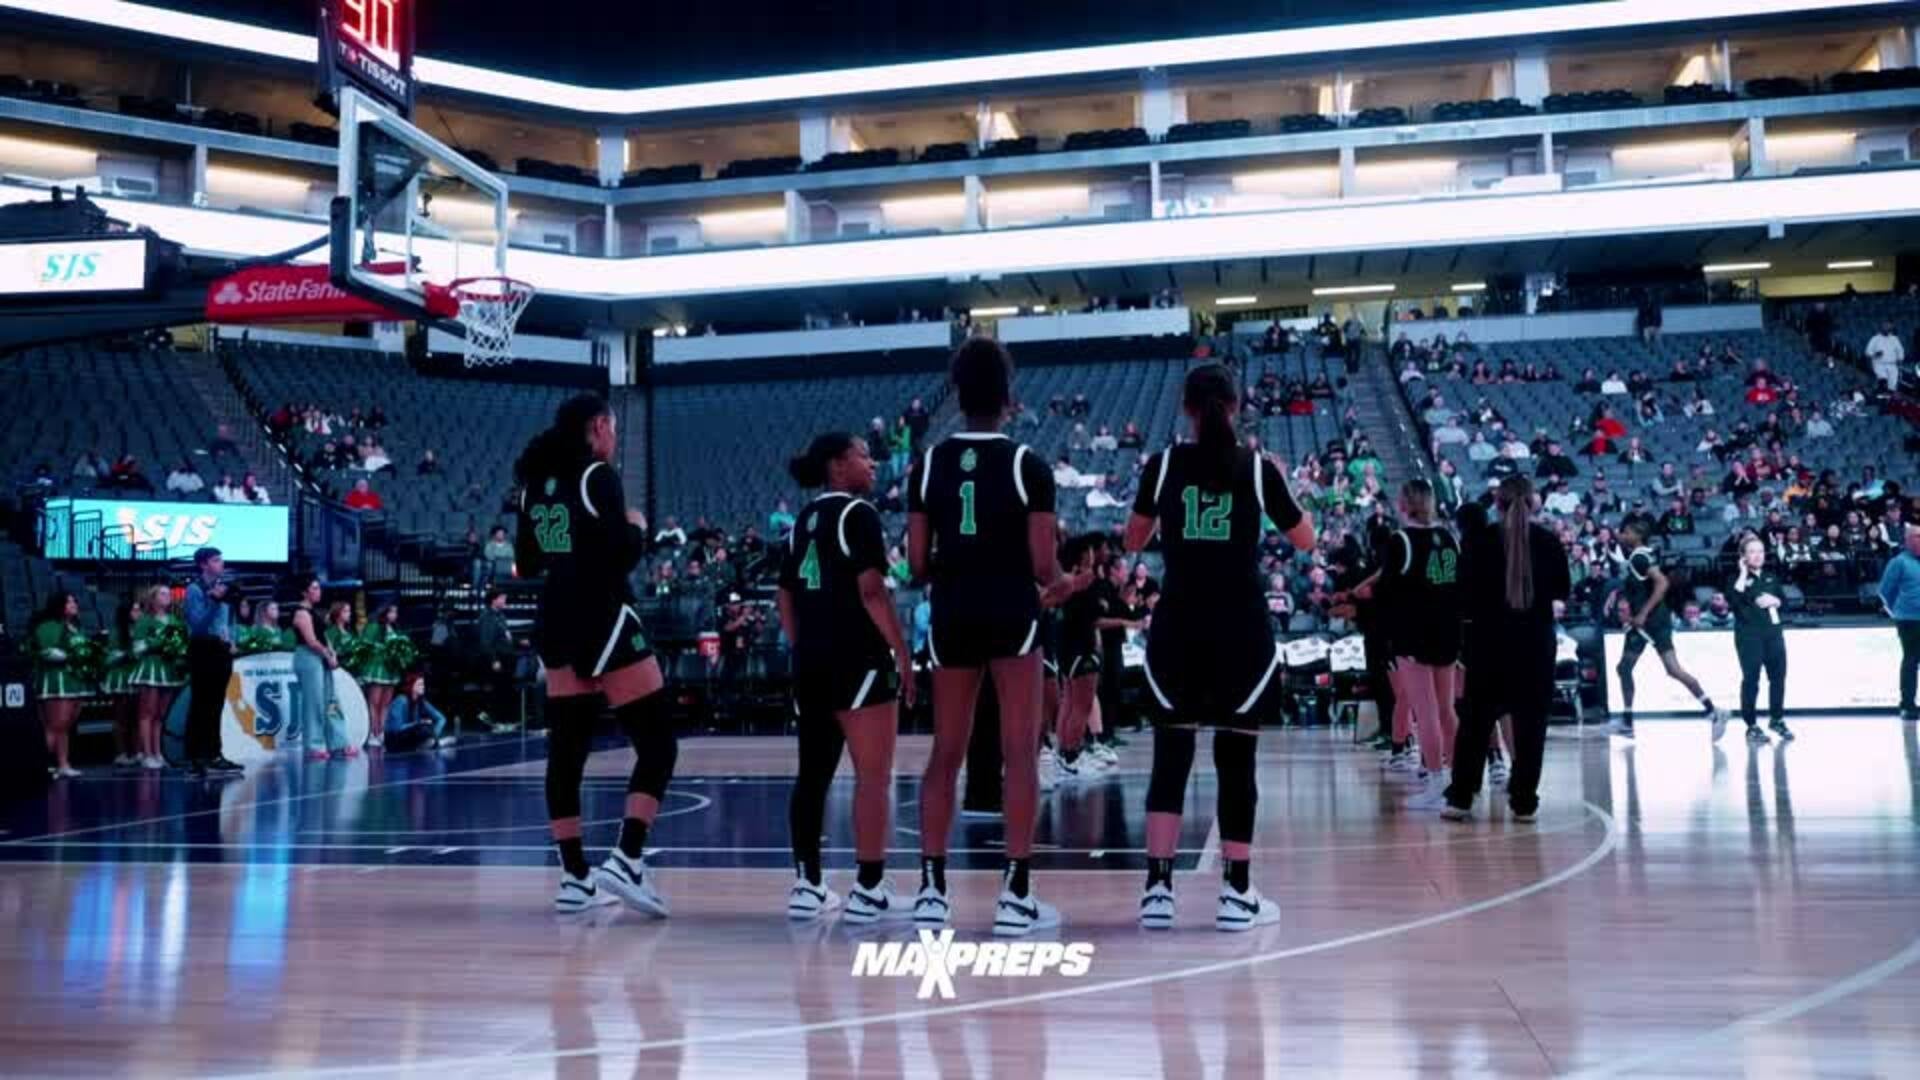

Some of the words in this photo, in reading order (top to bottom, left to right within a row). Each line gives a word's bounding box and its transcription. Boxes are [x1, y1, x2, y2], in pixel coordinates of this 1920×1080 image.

[359, 53, 407, 97] TISSOT
[41, 252, 101, 282] SJS
[142, 512, 219, 548] SJS
[530, 503, 572, 552] 22
[959, 481, 977, 535] 1
[1181, 485, 1233, 540] 12
[799, 540, 821, 590] 4
[1426, 548, 1457, 584] 42
